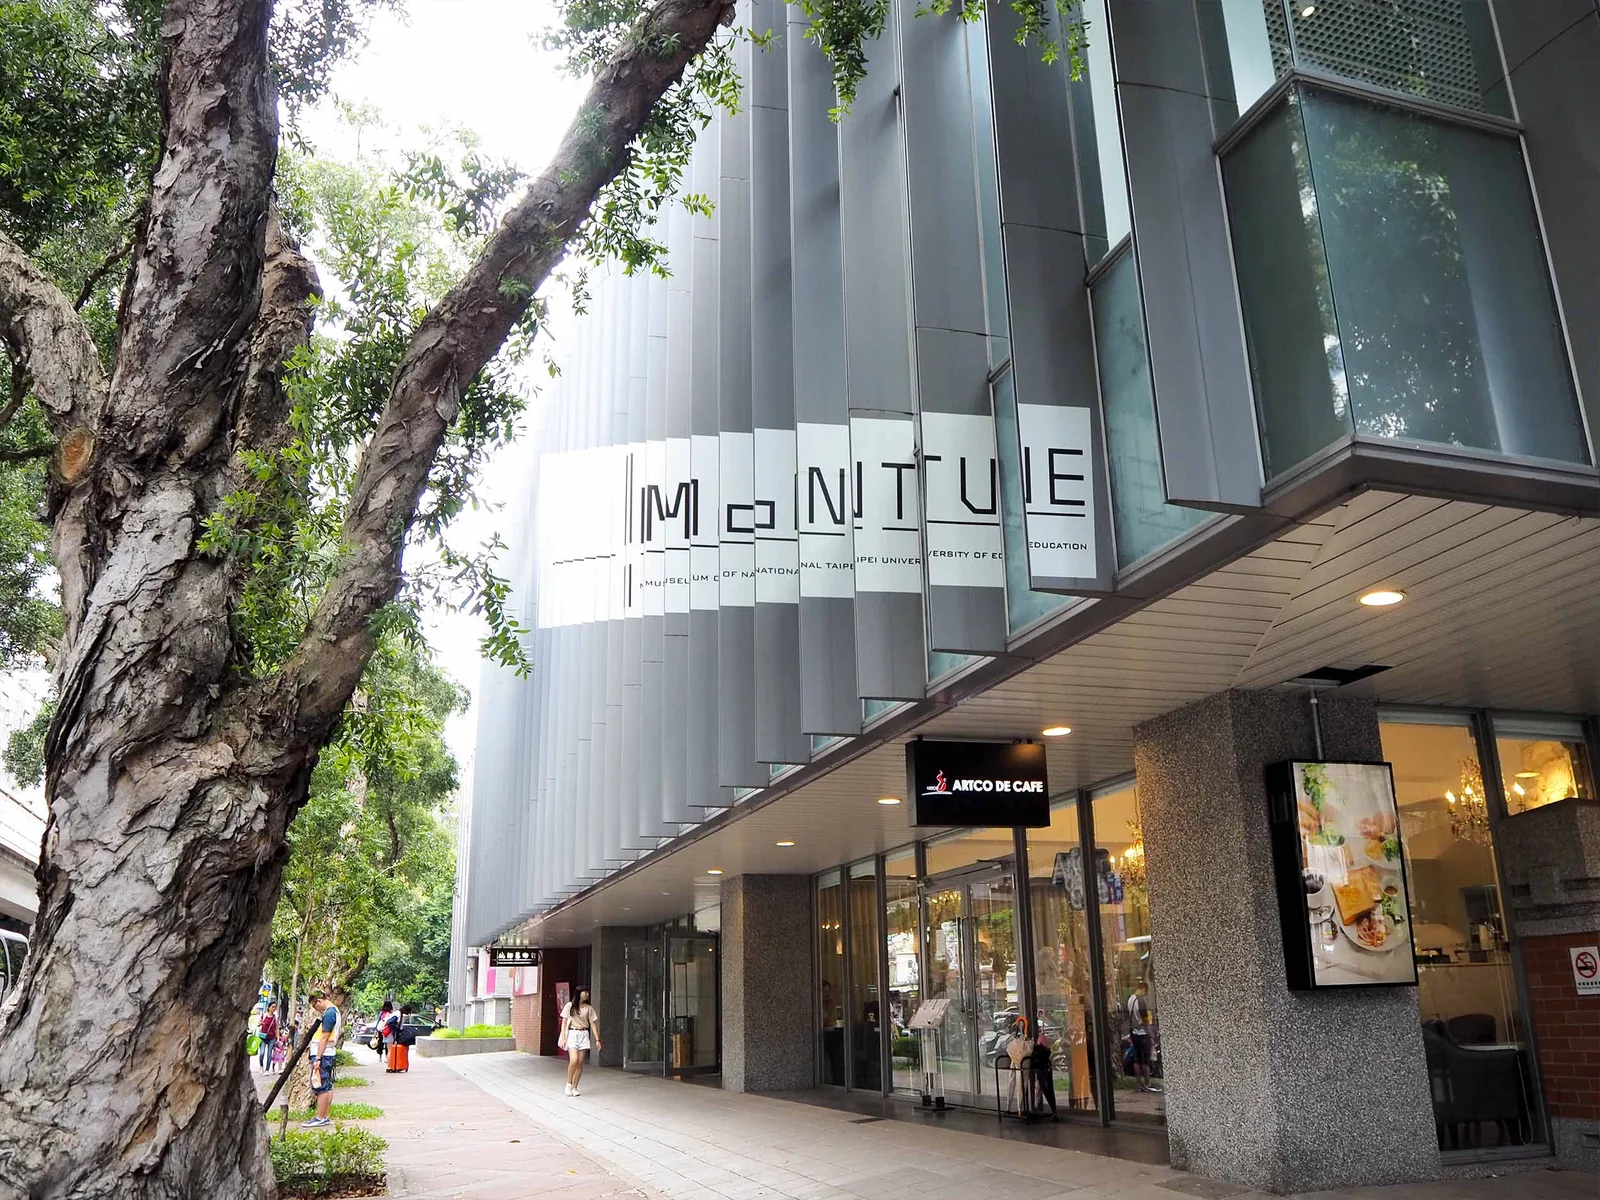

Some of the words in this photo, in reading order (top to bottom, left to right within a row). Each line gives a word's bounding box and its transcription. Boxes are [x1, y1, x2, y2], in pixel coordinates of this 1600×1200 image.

[826, 556, 878, 570] TAIPEI
[973, 551, 987, 559] OF
[952, 779, 993, 792] ARTCO
[995, 780, 1010, 792] DE
[1012, 780, 1044, 793] CAFE
